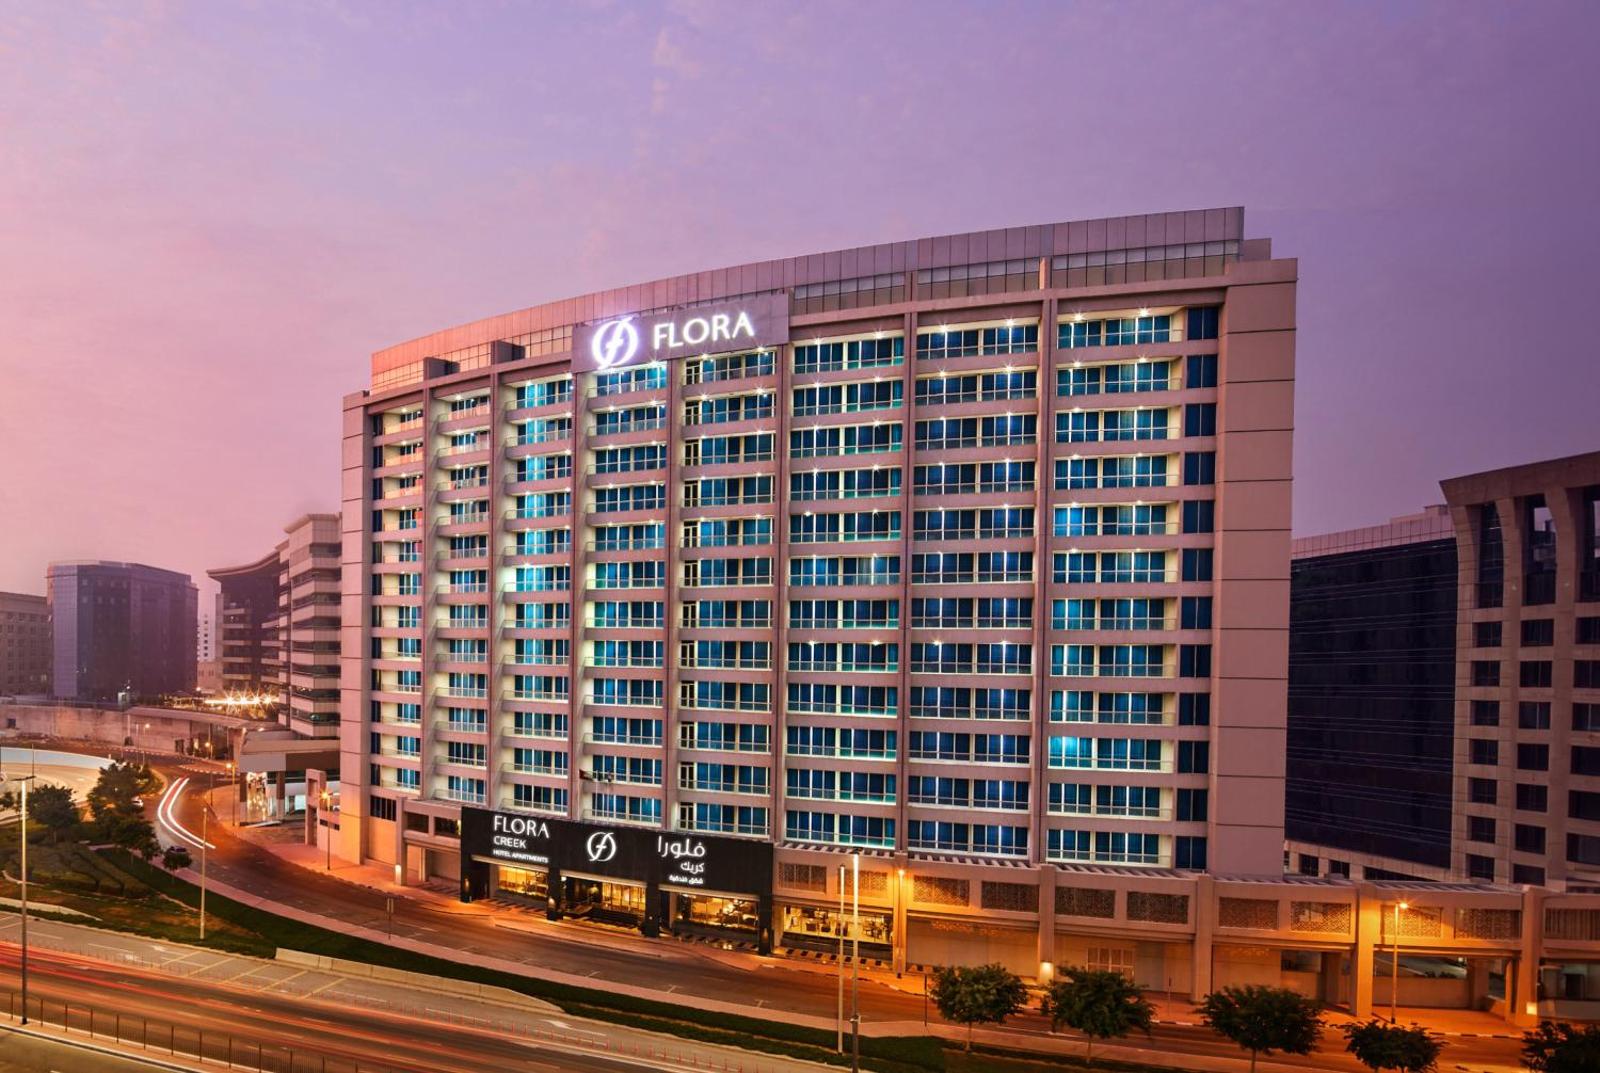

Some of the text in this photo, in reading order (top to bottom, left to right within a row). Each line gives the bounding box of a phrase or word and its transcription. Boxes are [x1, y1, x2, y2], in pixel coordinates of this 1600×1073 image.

[653, 311, 755, 350] FLORA
[494, 815, 550, 839] FLORA
[493, 835, 527, 849] CREEK
[657, 835, 706, 859] فلورا
[492, 849, 549, 864] HOTEL APARTMENTS
[680, 861, 705, 875] كريك
